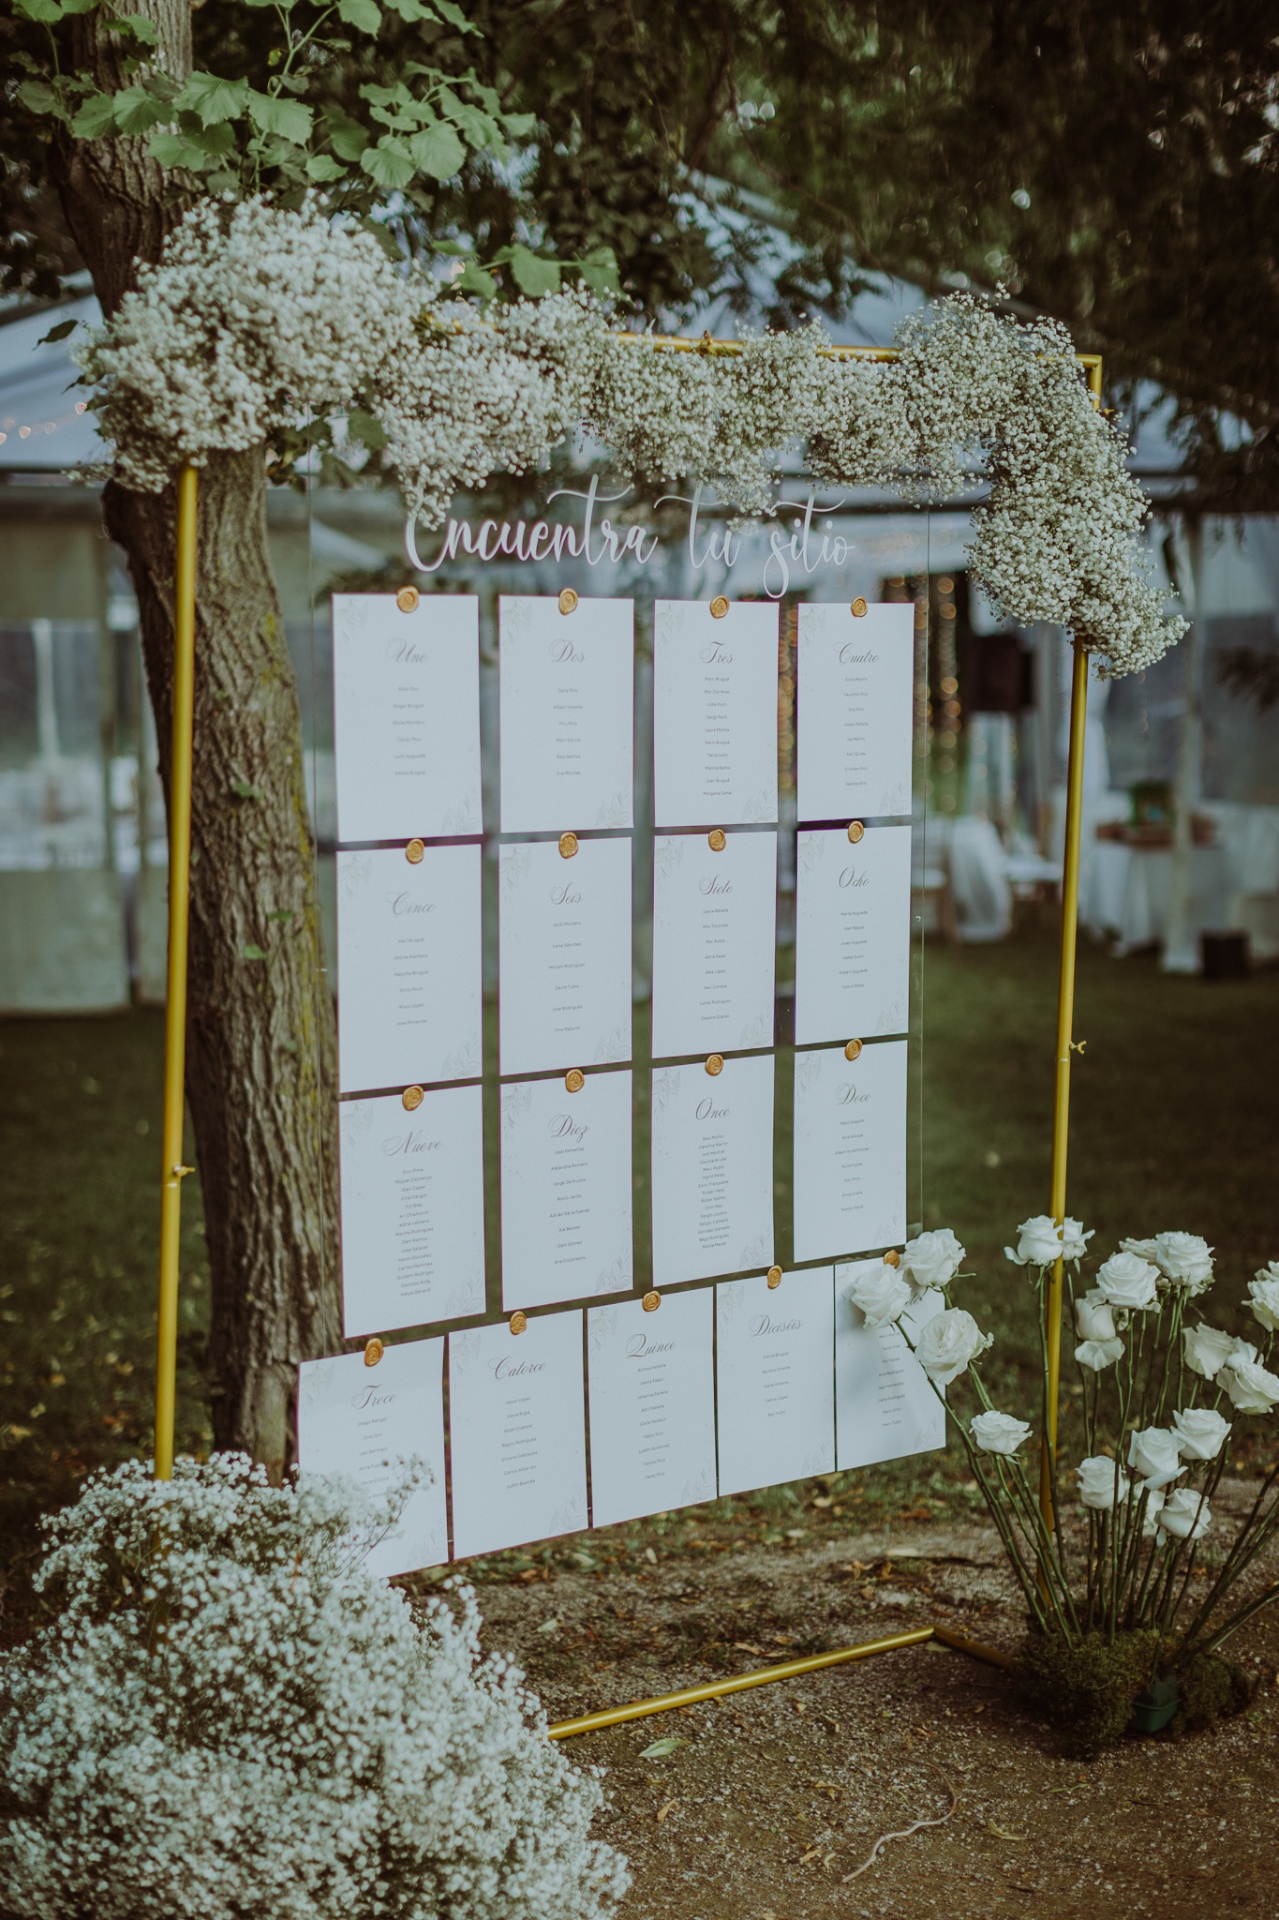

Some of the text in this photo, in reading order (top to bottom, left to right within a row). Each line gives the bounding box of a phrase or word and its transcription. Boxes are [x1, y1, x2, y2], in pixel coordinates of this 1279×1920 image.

[654, 482, 741, 568] tu
[763, 487, 855, 598] sitio
[549, 638, 585, 663] Dos
[700, 641, 734, 664] Tres
[833, 642, 880, 664] Cuatro
[699, 873, 733, 895] Siete
[838, 866, 870, 888] Ocho
[385, 891, 436, 917] Cinco
[551, 882, 583, 905] Seis
[835, 1083, 870, 1106] Doce
[696, 1097, 730, 1121] Once
[548, 1114, 589, 1143] Diez
[382, 1129, 442, 1156] Nueve
[625, 1333, 676, 1359] Quince
[488, 1356, 546, 1382] Catorce
[351, 1385, 396, 1410] Trece
